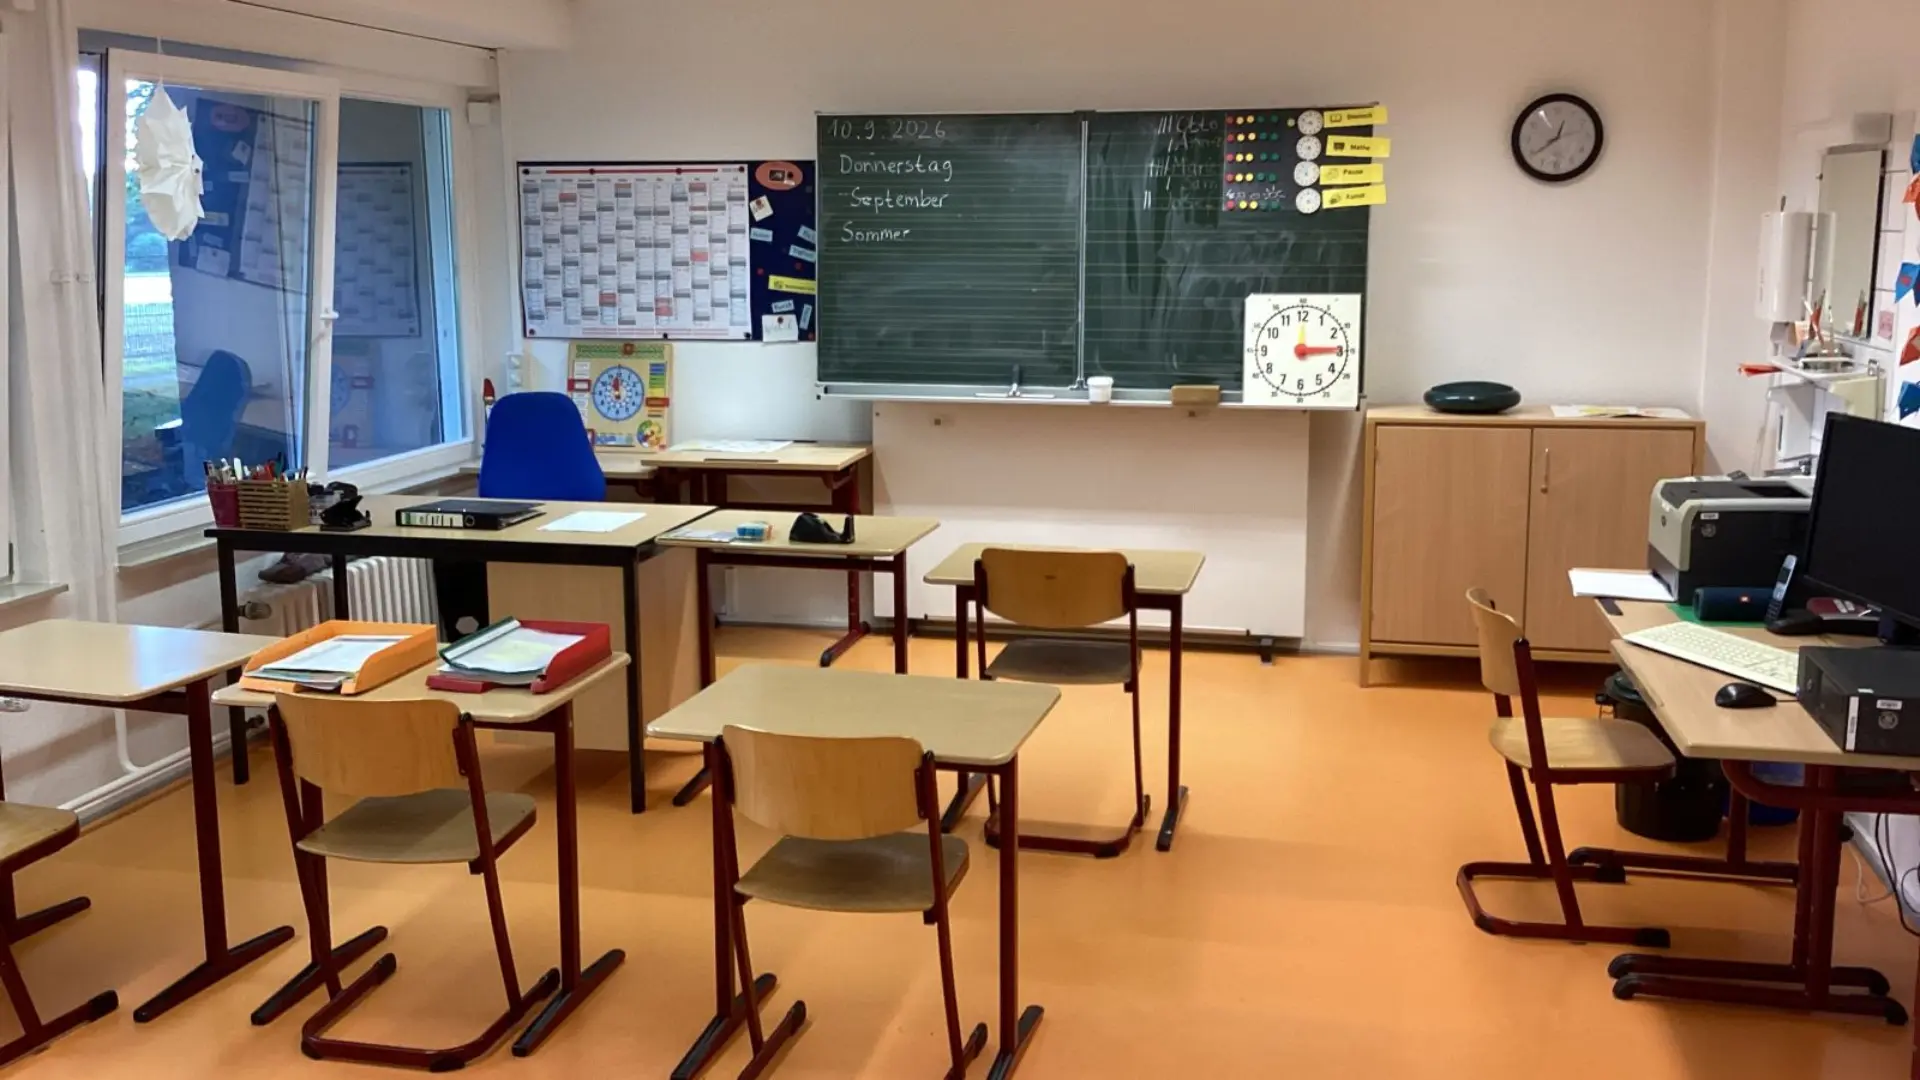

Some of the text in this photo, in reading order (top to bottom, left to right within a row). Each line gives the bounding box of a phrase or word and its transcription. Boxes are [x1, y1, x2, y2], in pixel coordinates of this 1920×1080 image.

[839, 154, 953, 182] Donnerstag
[850, 187, 949, 214] September
[840, 220, 911, 243] Sommer
[1281, 314, 1291, 327] 11
[1297, 310, 1309, 323] 12
[1319, 314, 1324, 327] 1
[1267, 327, 1279, 339] 10
[1330, 327, 1338, 340] 2
[1260, 344, 1268, 357] 9
[1335, 344, 1344, 357] 3
[1266, 362, 1273, 375] 8
[1328, 362, 1336, 374] 4
[1279, 373, 1287, 386] 7
[1296, 379, 1304, 391] 6
[1315, 374, 1323, 387] 5
